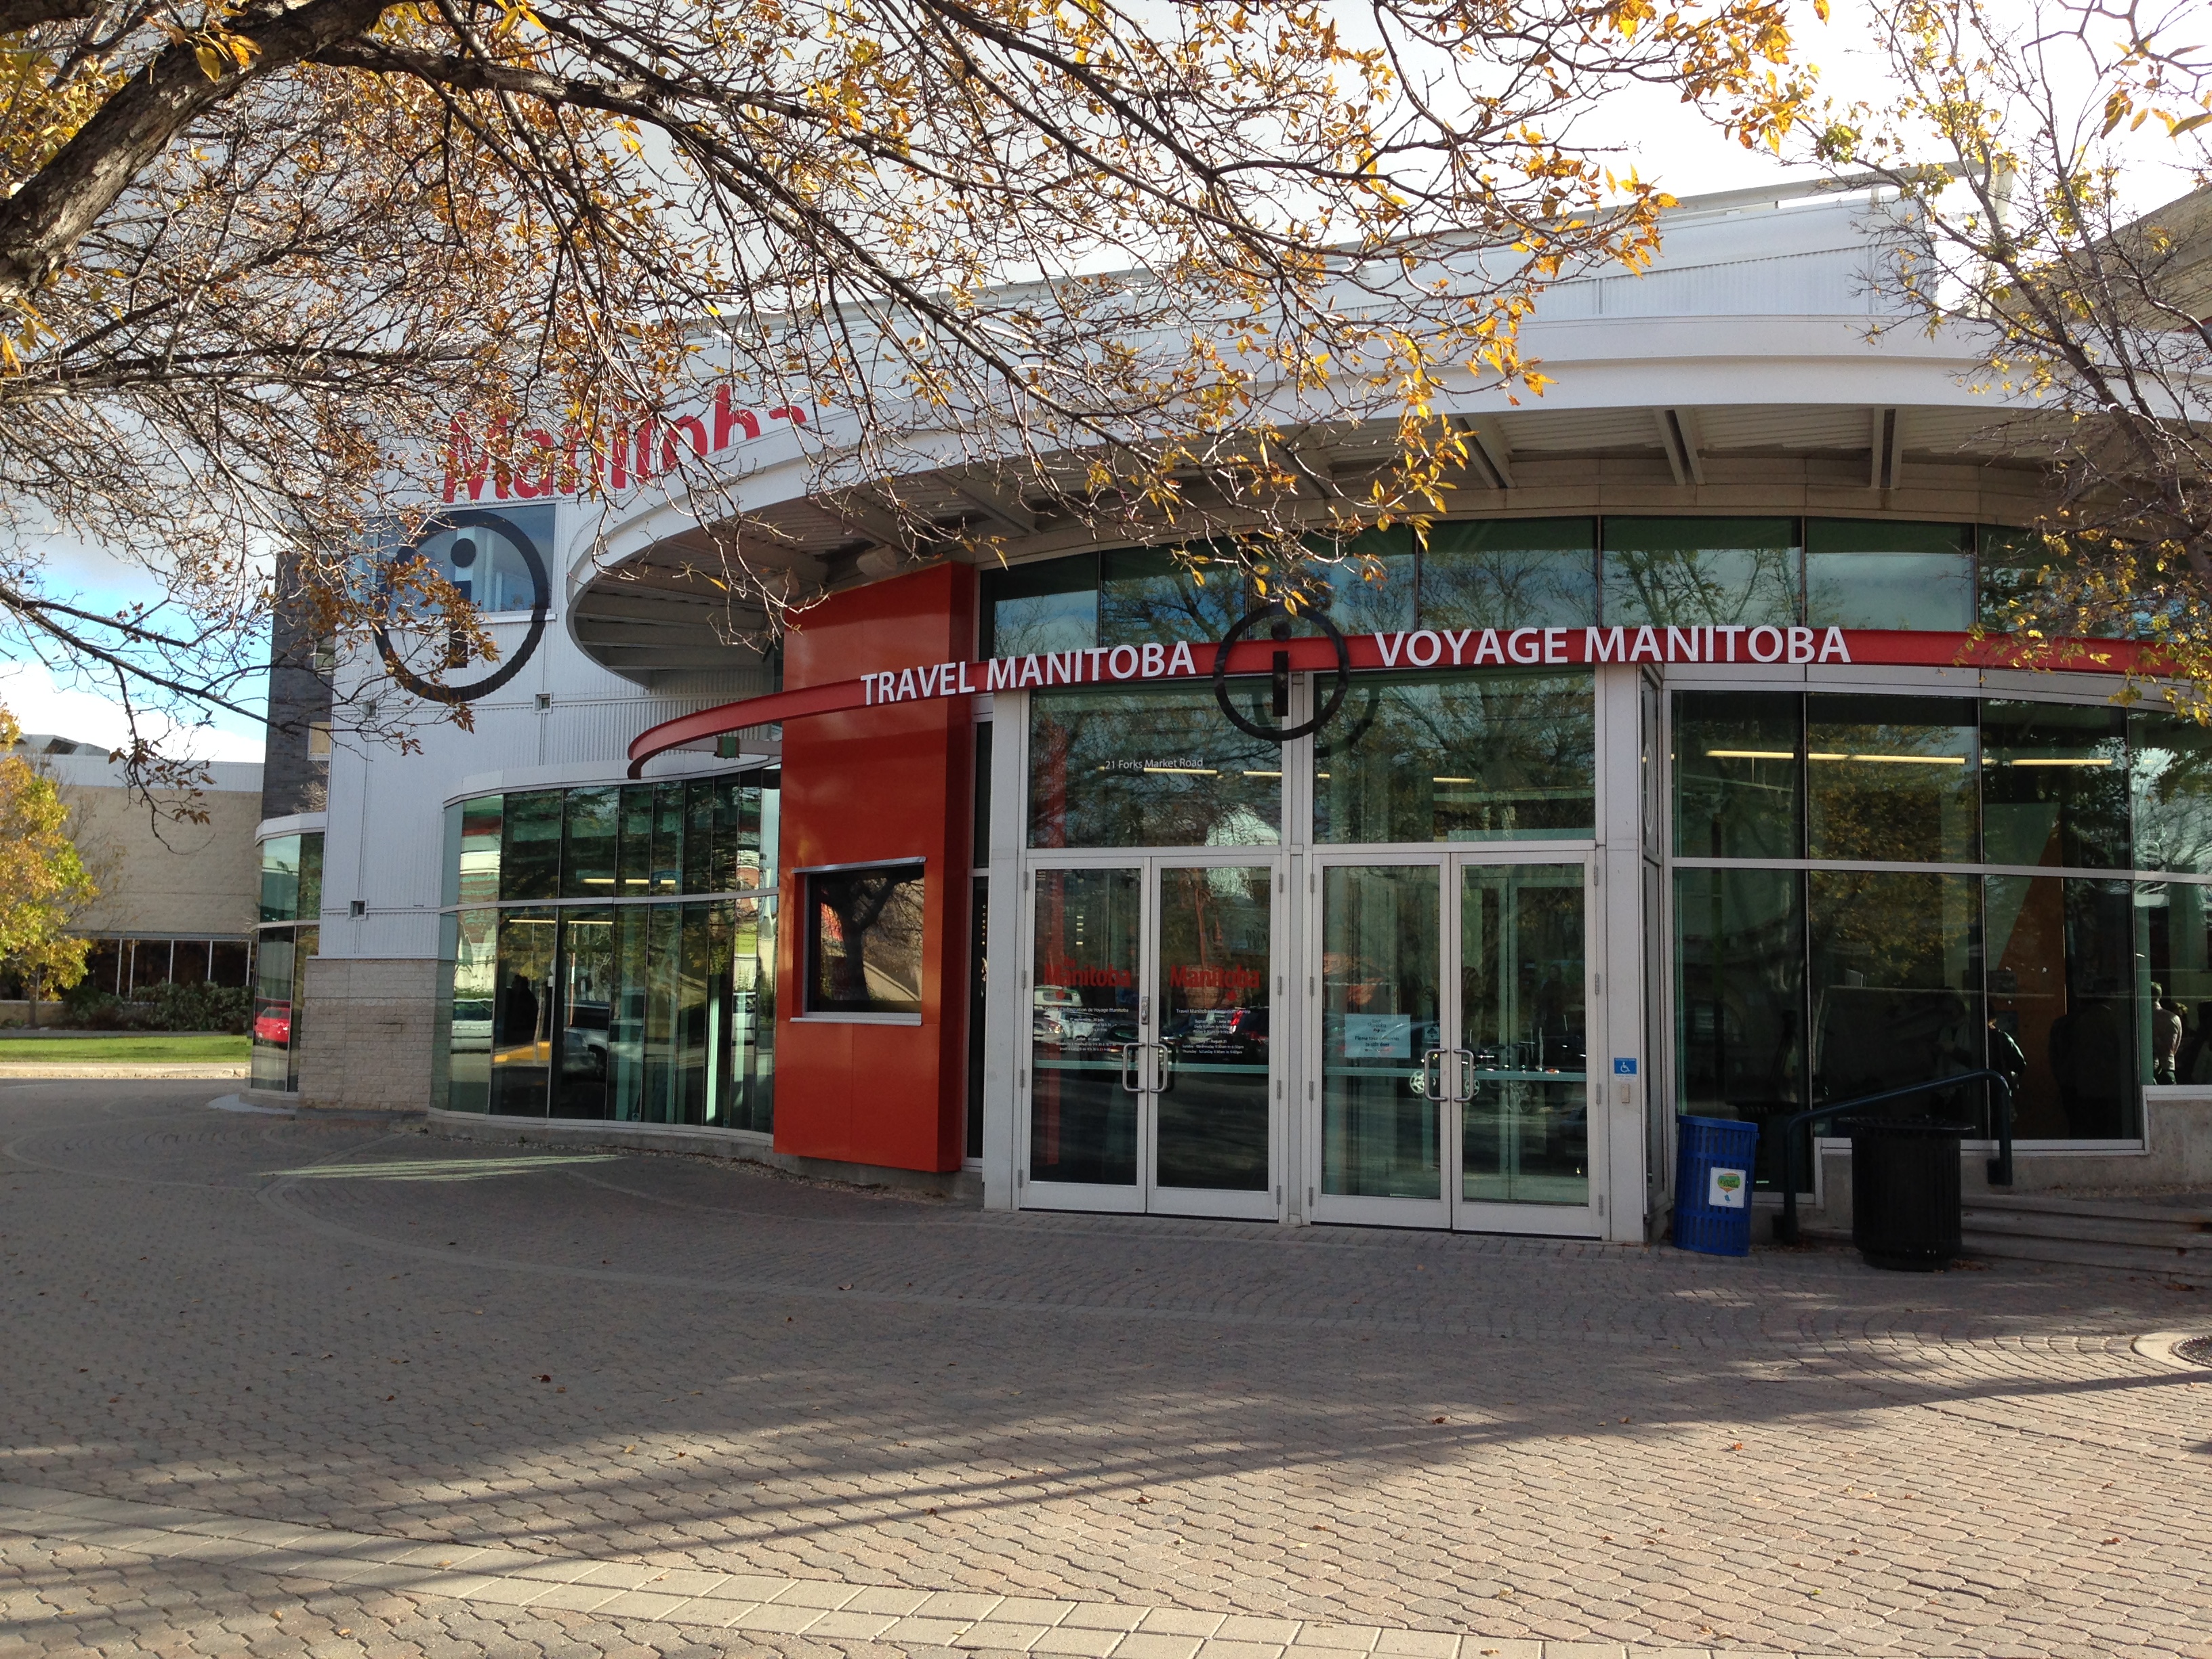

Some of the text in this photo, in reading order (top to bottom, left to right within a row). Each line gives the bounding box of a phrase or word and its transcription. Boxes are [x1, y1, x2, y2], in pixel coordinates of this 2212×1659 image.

[1374, 625, 1851, 667] VOYAGE MANITOBA
[860, 640, 1196, 705] TRAVEL MANITOBA
[1105, 757, 1204, 770] 21 Forks Market Road
[1044, 962, 1132, 987] Manitoba
[1170, 964, 1261, 988] Manitoba
